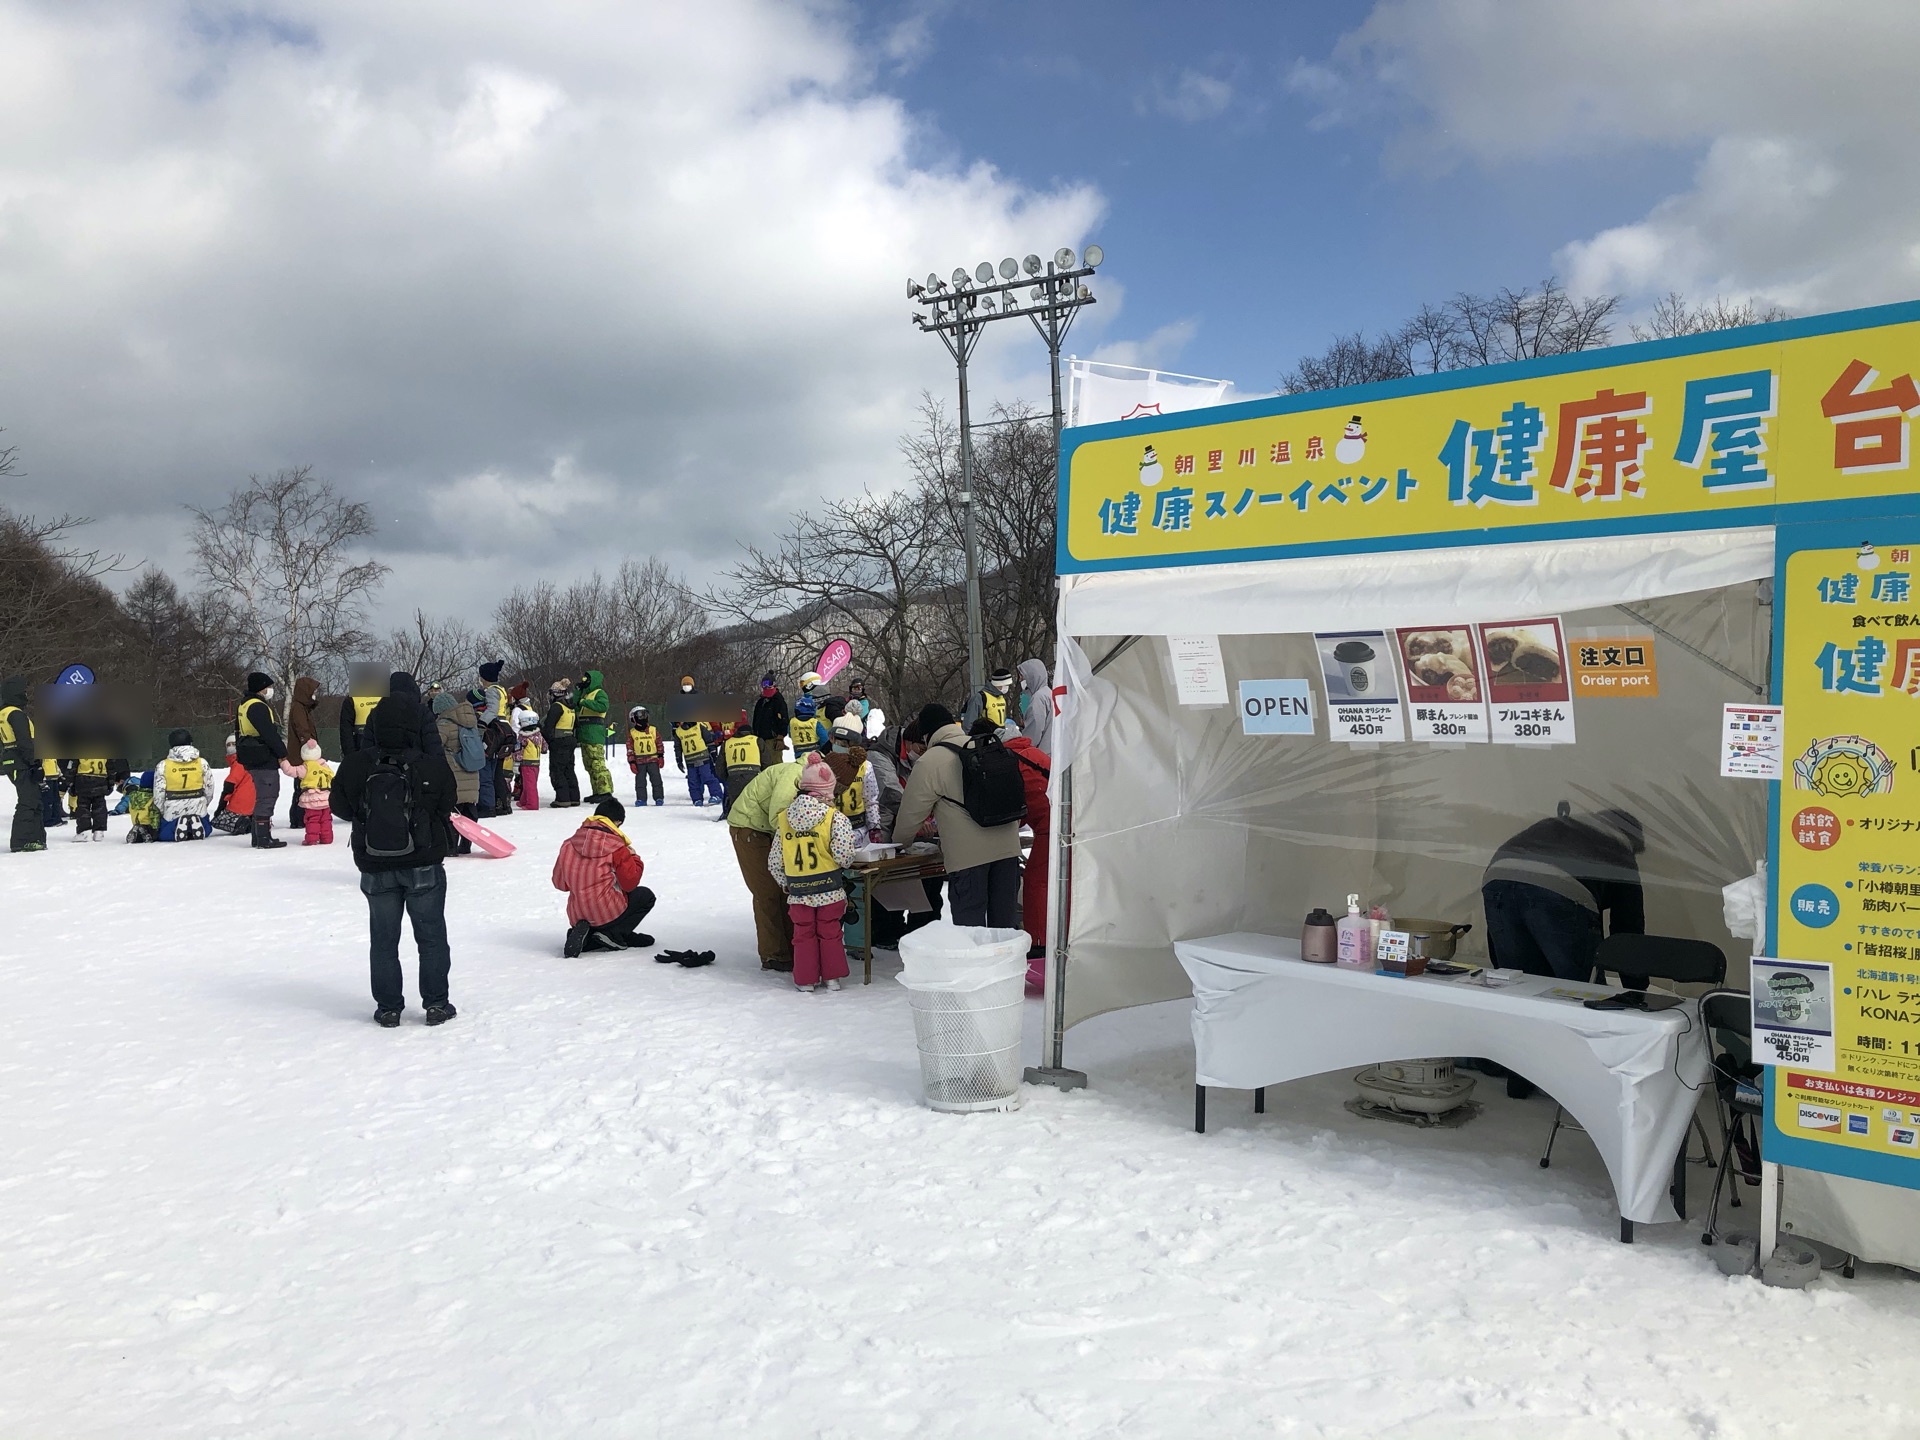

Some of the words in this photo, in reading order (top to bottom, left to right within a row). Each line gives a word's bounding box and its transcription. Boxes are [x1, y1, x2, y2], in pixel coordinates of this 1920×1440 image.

[1438, 359, 1920, 510] 健康屋台
[1174, 436, 1325, 475] 朝里川温泉
[1098, 468, 1420, 536] 健康スノーイベント
[1891, 549, 1911, 564] 朝
[1817, 571, 1911, 605] 健康
[1579, 645, 1645, 667] 注文口
[1581, 675, 1617, 686] Order
[1621, 675, 1650, 687] port
[1245, 697, 1309, 717] OPEN
[1498, 708, 1565, 721] ブルコギまん
[1339, 714, 1363, 722] KONA
[1416, 709, 1448, 721] 豚まん
[1350, 724, 1383, 735] 450円
[1432, 723, 1466, 735] 380円
[1514, 724, 1551, 736] 380円
[639, 741, 651, 753] 26
[685, 739, 697, 753] 23
[732, 747, 746, 763] 40
[181, 774, 188, 789] 7
[1799, 812, 1834, 828] 試飲
[1798, 829, 1832, 846] 試食
[794, 842, 818, 872] 45
[789, 879, 826, 889] FISCHER
[1797, 899, 1831, 915] 販売
[1862, 898, 1920, 913] 筋肉バー
[1763, 1036, 1791, 1046] KONA
[1793, 1040, 1822, 1049] コーヒー
[1776, 1051, 1810, 1063] 450円
[1804, 1079, 1920, 1104] お支払いは各種クレジッ
[1800, 1110, 1840, 1123] DISCOVER
